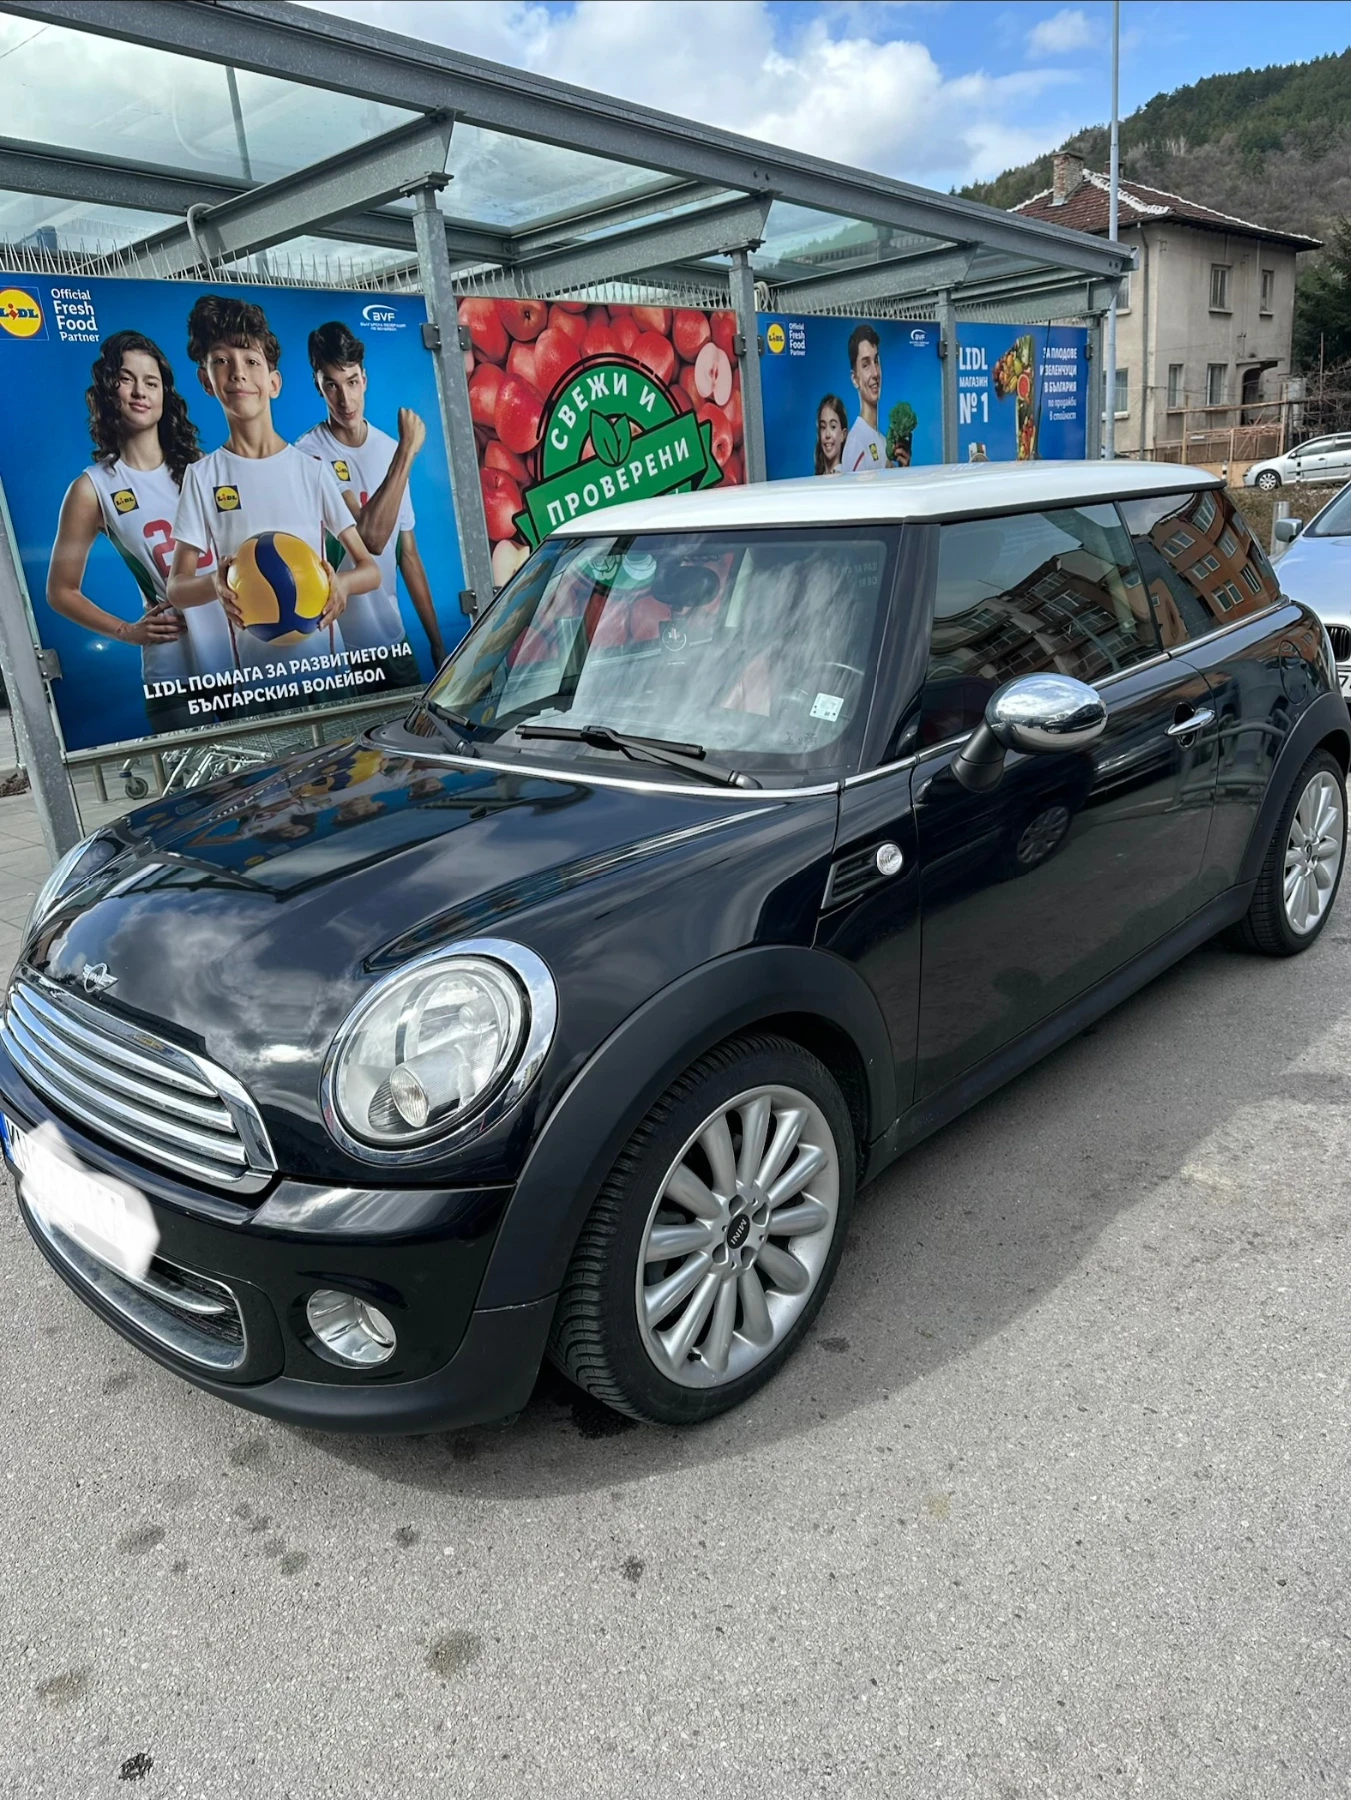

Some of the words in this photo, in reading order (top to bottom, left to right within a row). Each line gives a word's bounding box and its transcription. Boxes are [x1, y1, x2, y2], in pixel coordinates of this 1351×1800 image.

[50, 287, 92, 301] Official
[52, 300, 95, 316] Fresh
[56, 315, 99, 331] Food
[372, 311, 396, 322] BVF
[59, 331, 100, 342] Partner
[789, 339, 806, 349] Food
[959, 347, 988, 370] LIDL
[1051, 347, 1078, 361] ПЛОДОВЕ
[959, 376, 988, 388] МАГАЗИН
[1049, 381, 1077, 392] БЪЛГАРИЯ
[551, 372, 628, 450] СВЕЖИ
[638, 385, 657, 413] И
[980, 392, 989, 423] 1
[546, 437, 690, 526] ПРОВЕРЕНИ
[143, 680, 189, 700] LIDL
[188, 665, 264, 692] ПОМАГА
[266, 661, 288, 678] ЗА
[290, 646, 389, 675] РАЗВИТИЕТО
[390, 641, 413, 659] НА
[187, 682, 300, 716] БЪЛГАРСКИЯ
[301, 667, 386, 695] ВОЛЕЙБОЛ
[730, 1218, 748, 1245] MINI
